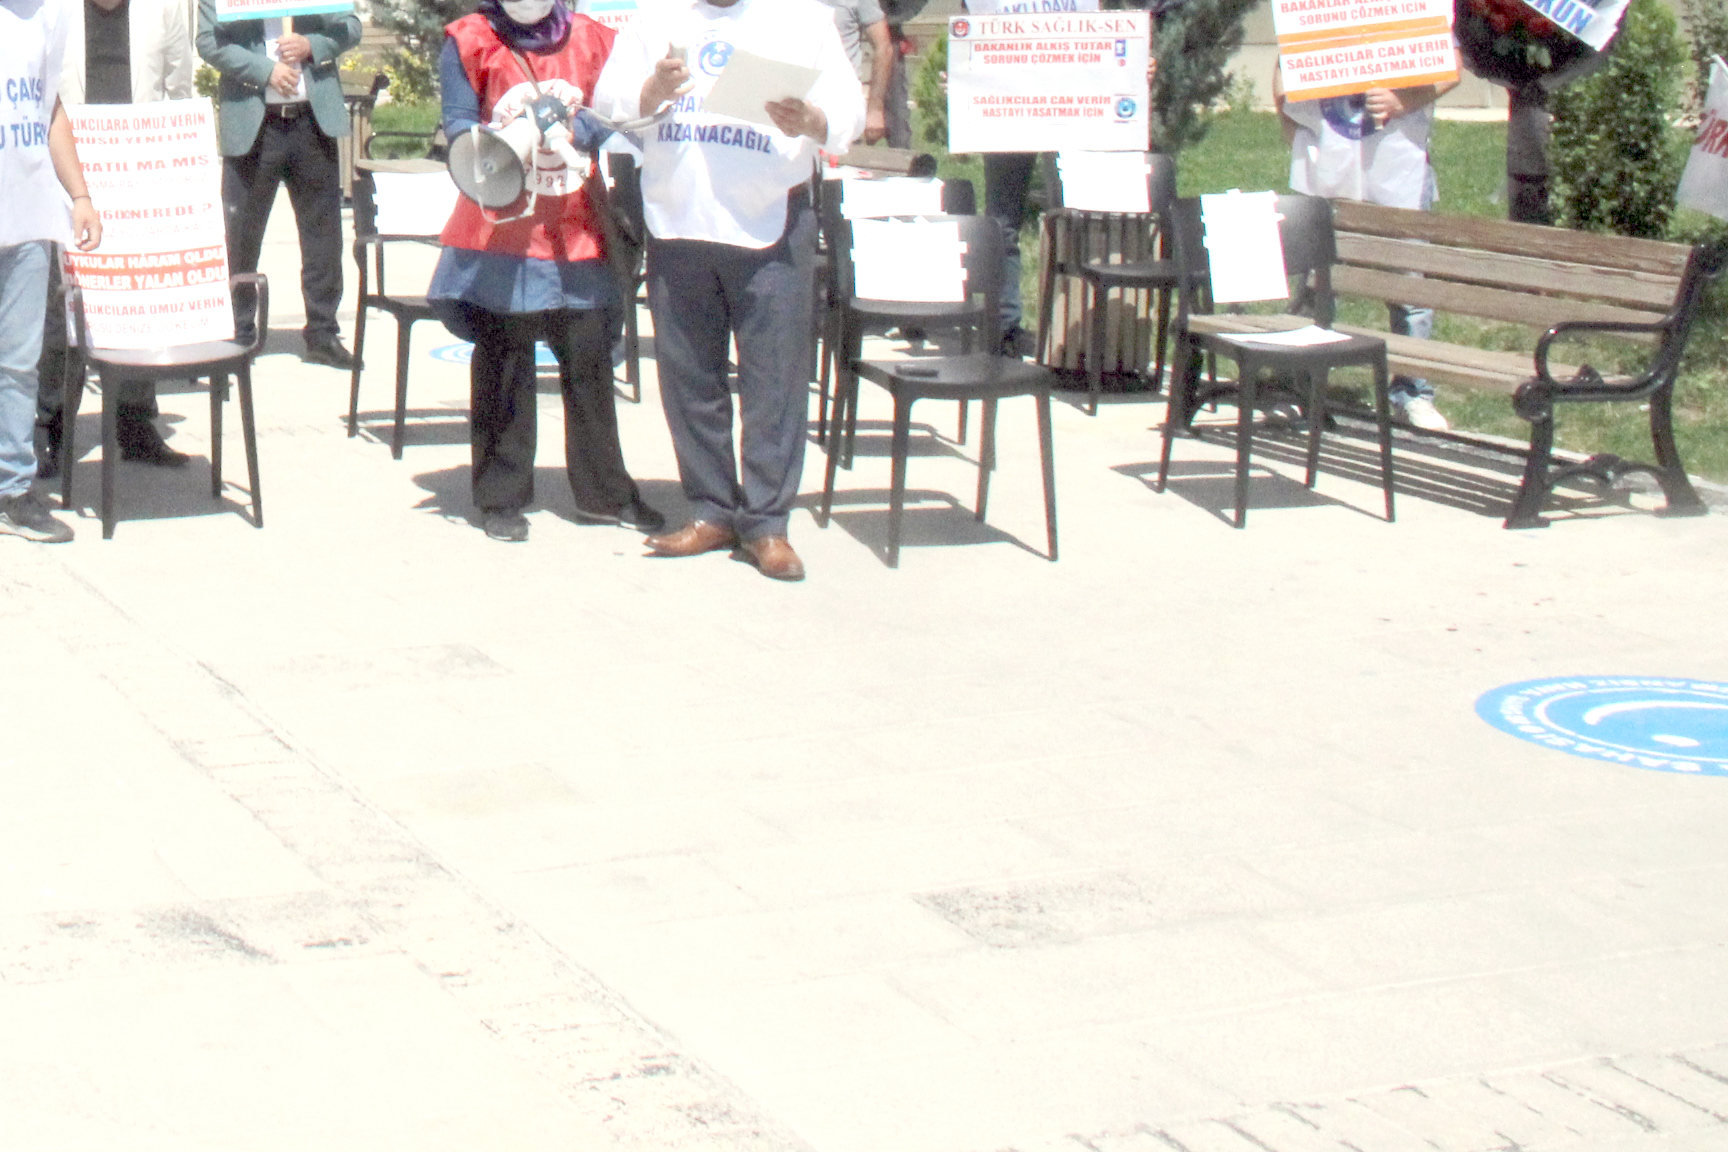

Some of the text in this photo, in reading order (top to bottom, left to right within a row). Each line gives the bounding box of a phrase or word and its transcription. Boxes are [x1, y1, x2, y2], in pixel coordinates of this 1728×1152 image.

[978, 16, 1137, 35] TÜRK SAĞLIK-SEN
[1377, 45, 1405, 58] CAN
[184, 248, 224, 264] OLDU
[134, 271, 184, 290] YALAN
[187, 266, 227, 285] OLDU
